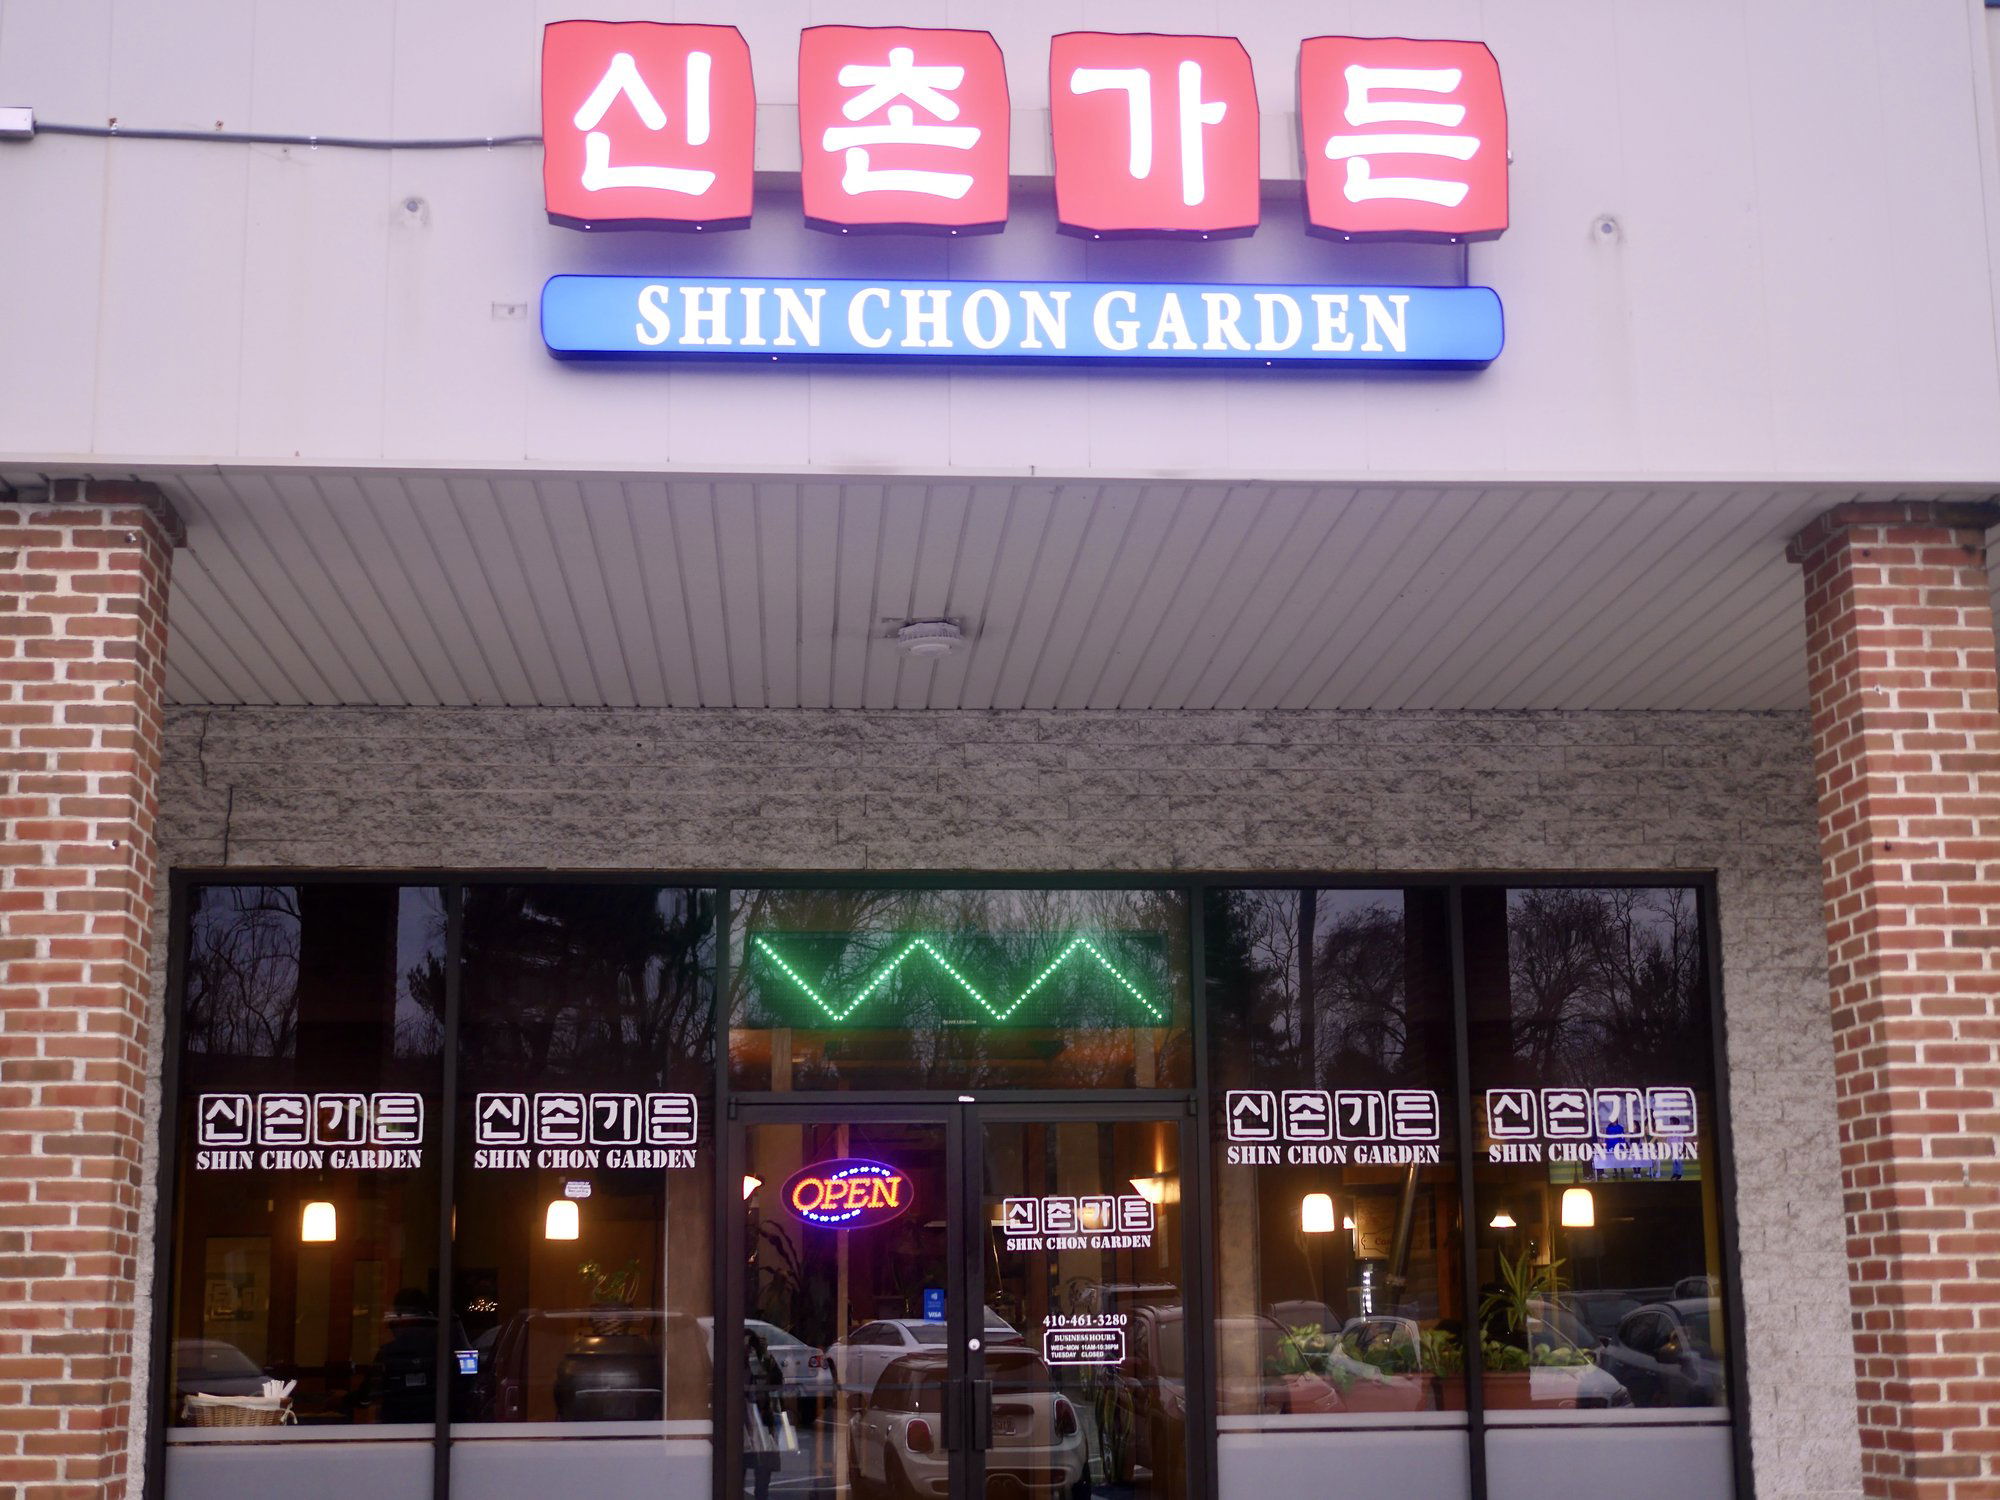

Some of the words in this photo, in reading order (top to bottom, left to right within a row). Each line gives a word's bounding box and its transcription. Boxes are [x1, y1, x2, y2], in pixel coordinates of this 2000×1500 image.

[574, 48, 1481, 207] 신촌가든
[635, 285, 826, 349] SHIN
[847, 288, 1072, 351] CHON
[1094, 290, 1410, 353] GARDEN
[205, 1098, 418, 1140] 신촌가든
[482, 1097, 692, 1140] 신촌가든
[1232, 1095, 1434, 1136] 신촌가든
[1493, 1093, 1691, 1134] 신촌가든
[196, 1150, 254, 1170] SHIN
[260, 1150, 324, 1169] CHON
[330, 1149, 423, 1169] GARDEN
[474, 1149, 532, 1169] SHIN
[537, 1149, 601, 1168] CHON
[606, 1149, 698, 1168] GARDEN
[1227, 1145, 1281, 1164] SHIN
[1287, 1145, 1347, 1164] CHON
[1353, 1145, 1440, 1164] GARDEN
[1488, 1143, 1542, 1163] SHIN
[1548, 1142, 1609, 1162] CHON
[1613, 1141, 1698, 1160] GARDEN
[792, 1176, 902, 1211] OPEN
[1006, 1237, 1043, 1251] SHIN
[1046, 1236, 1088, 1250] CHON
[1091, 1235, 1151, 1249] GARDEN
[1043, 1313, 1127, 1327] 410-461-3280
[1054, 1333, 1088, 1342] BUSINESS
[1089, 1333, 1116, 1341] HOURS
